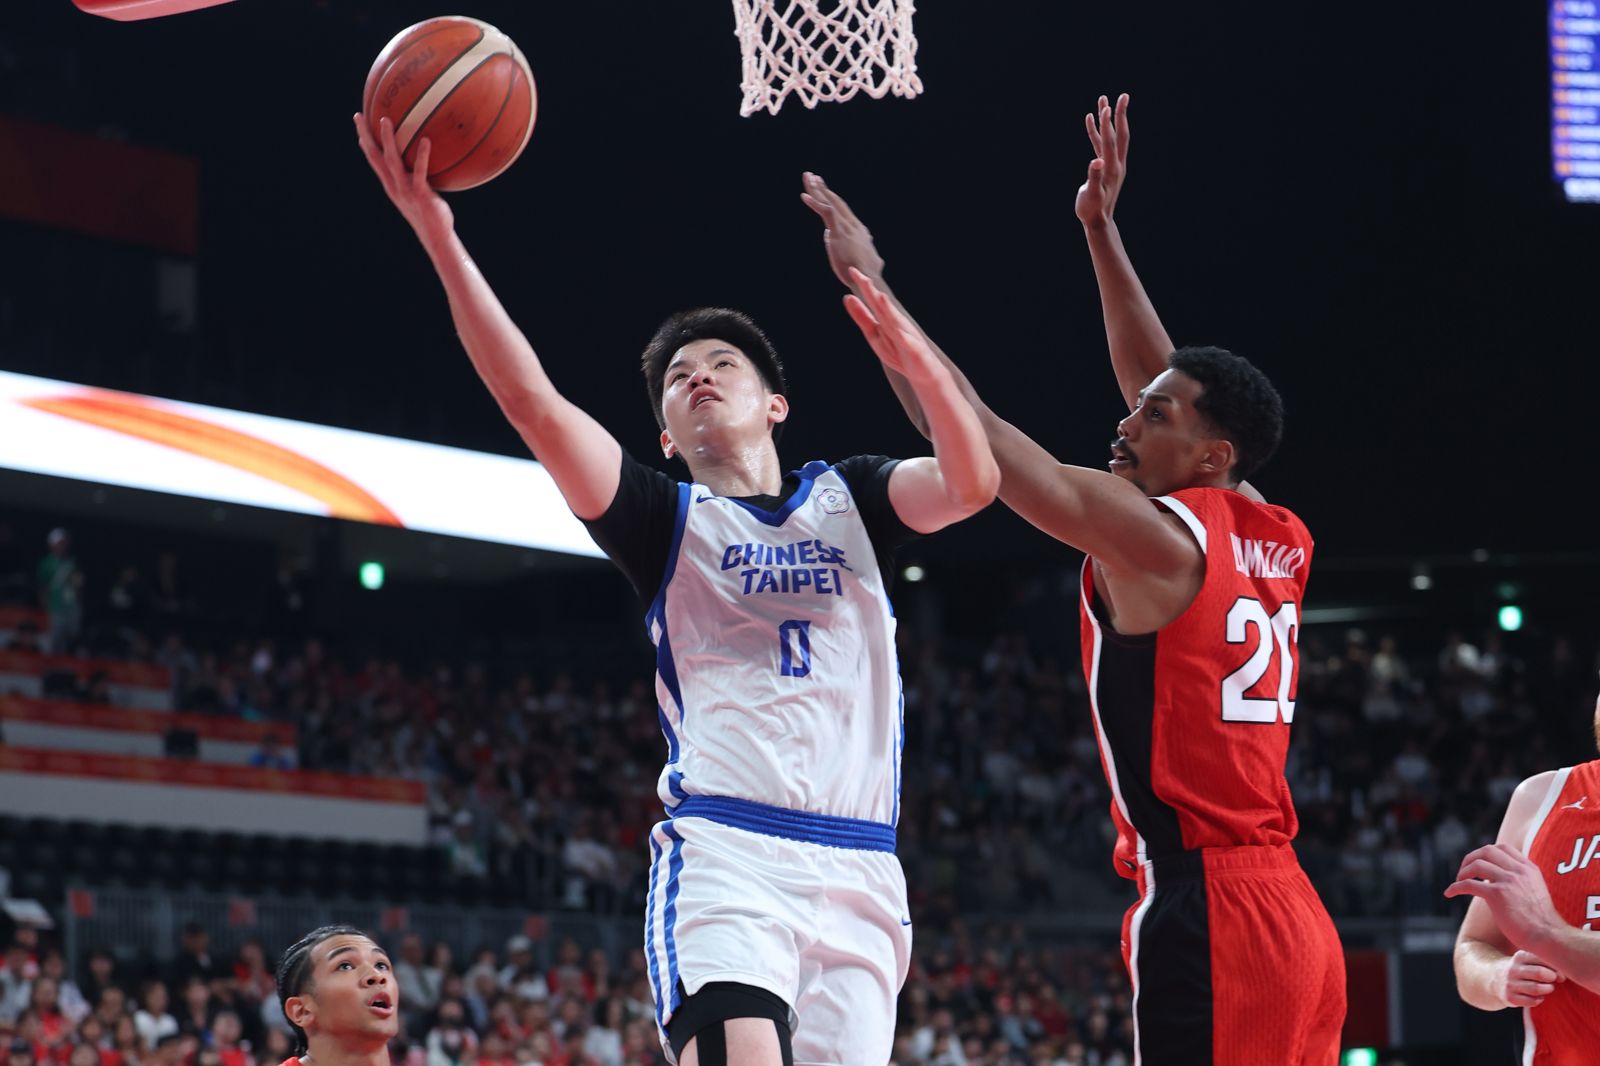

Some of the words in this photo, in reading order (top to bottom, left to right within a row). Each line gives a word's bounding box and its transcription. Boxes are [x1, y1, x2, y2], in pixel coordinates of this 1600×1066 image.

[720, 539, 853, 572] CHINESE
[740, 568, 844, 597] TAIPEI
[779, 619, 812, 678] 0
